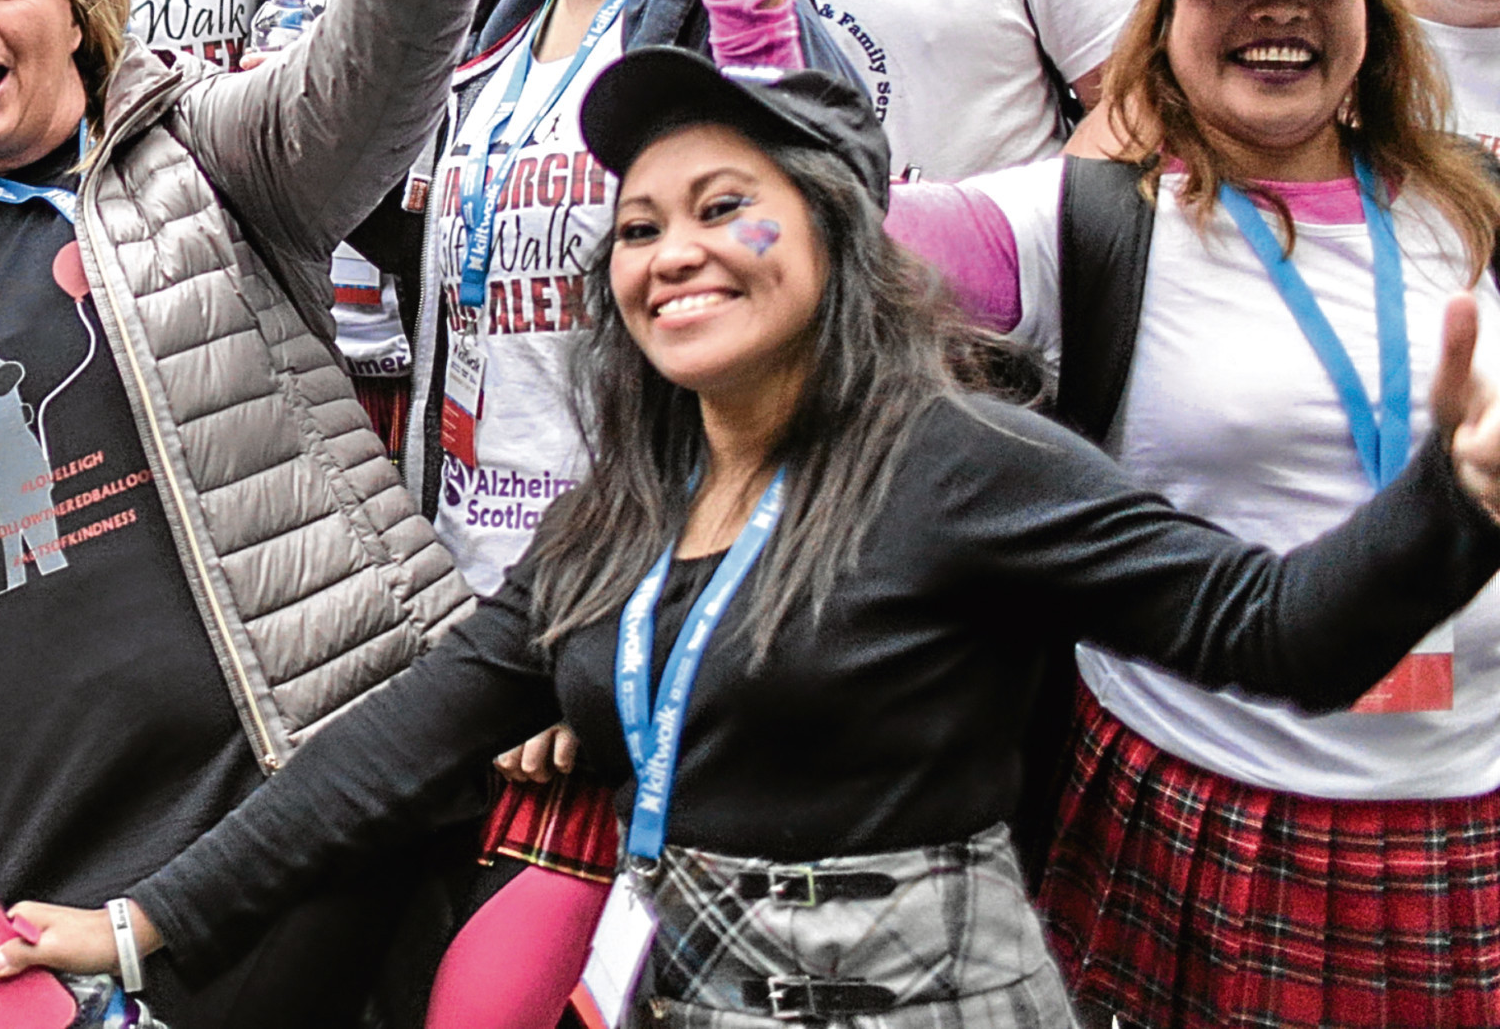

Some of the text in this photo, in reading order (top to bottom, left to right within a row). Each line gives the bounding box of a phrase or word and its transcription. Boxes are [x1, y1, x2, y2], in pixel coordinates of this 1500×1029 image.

[818, 3, 835, 20] &
[836, 12, 888, 75] Family
[471, 183, 500, 259] kiltwalk
[491, 202, 592, 274] Walk
[488, 275, 593, 335] ALEX
[21, 450, 104, 494] #LOVELEIGH
[13, 508, 137, 568] #ACTSOFKINDNESS
[641, 704, 677, 794] kiltwalk
